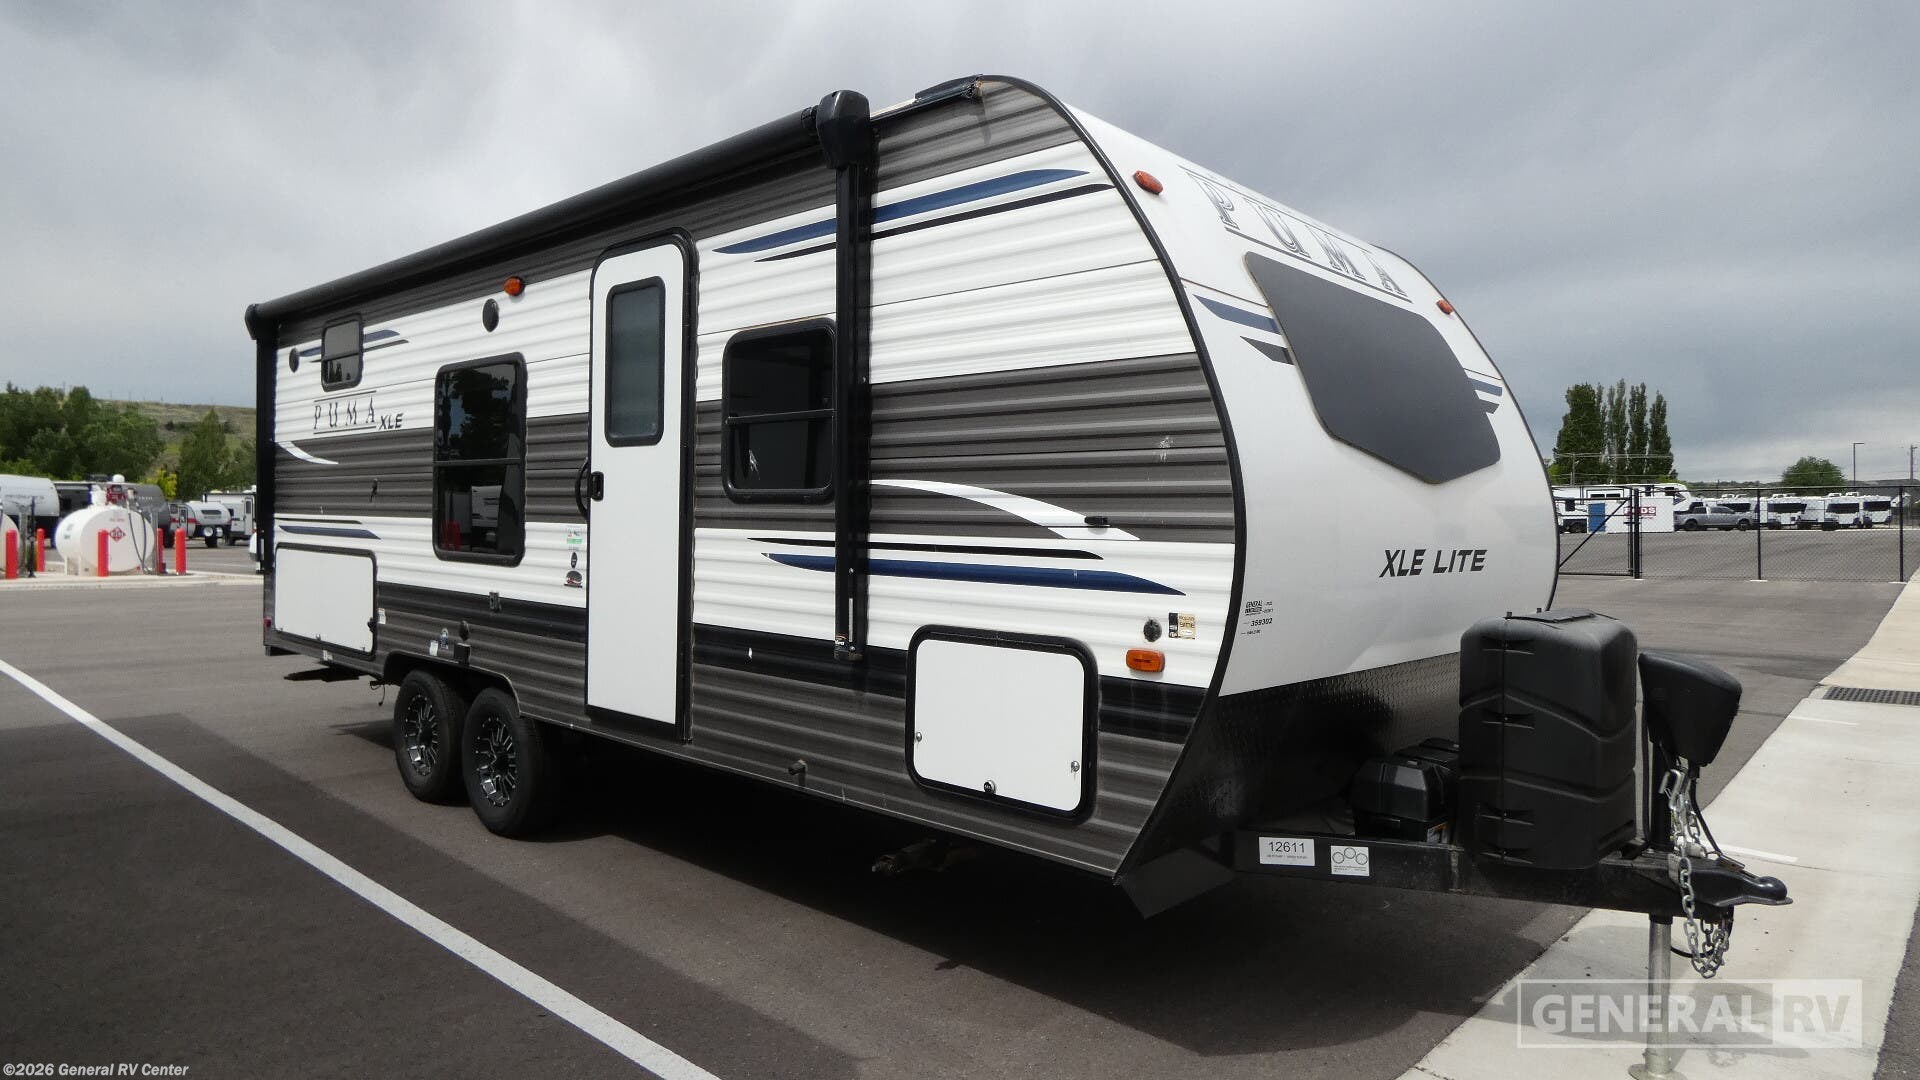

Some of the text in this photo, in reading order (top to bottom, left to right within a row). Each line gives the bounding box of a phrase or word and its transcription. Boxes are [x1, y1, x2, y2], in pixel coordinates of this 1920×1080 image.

[1184, 171, 1409, 298] PUMA
[313, 395, 404, 430] PUMA XLE
[1378, 548, 1488, 578] XLE LITE
[1268, 841, 1305, 854] 12611
